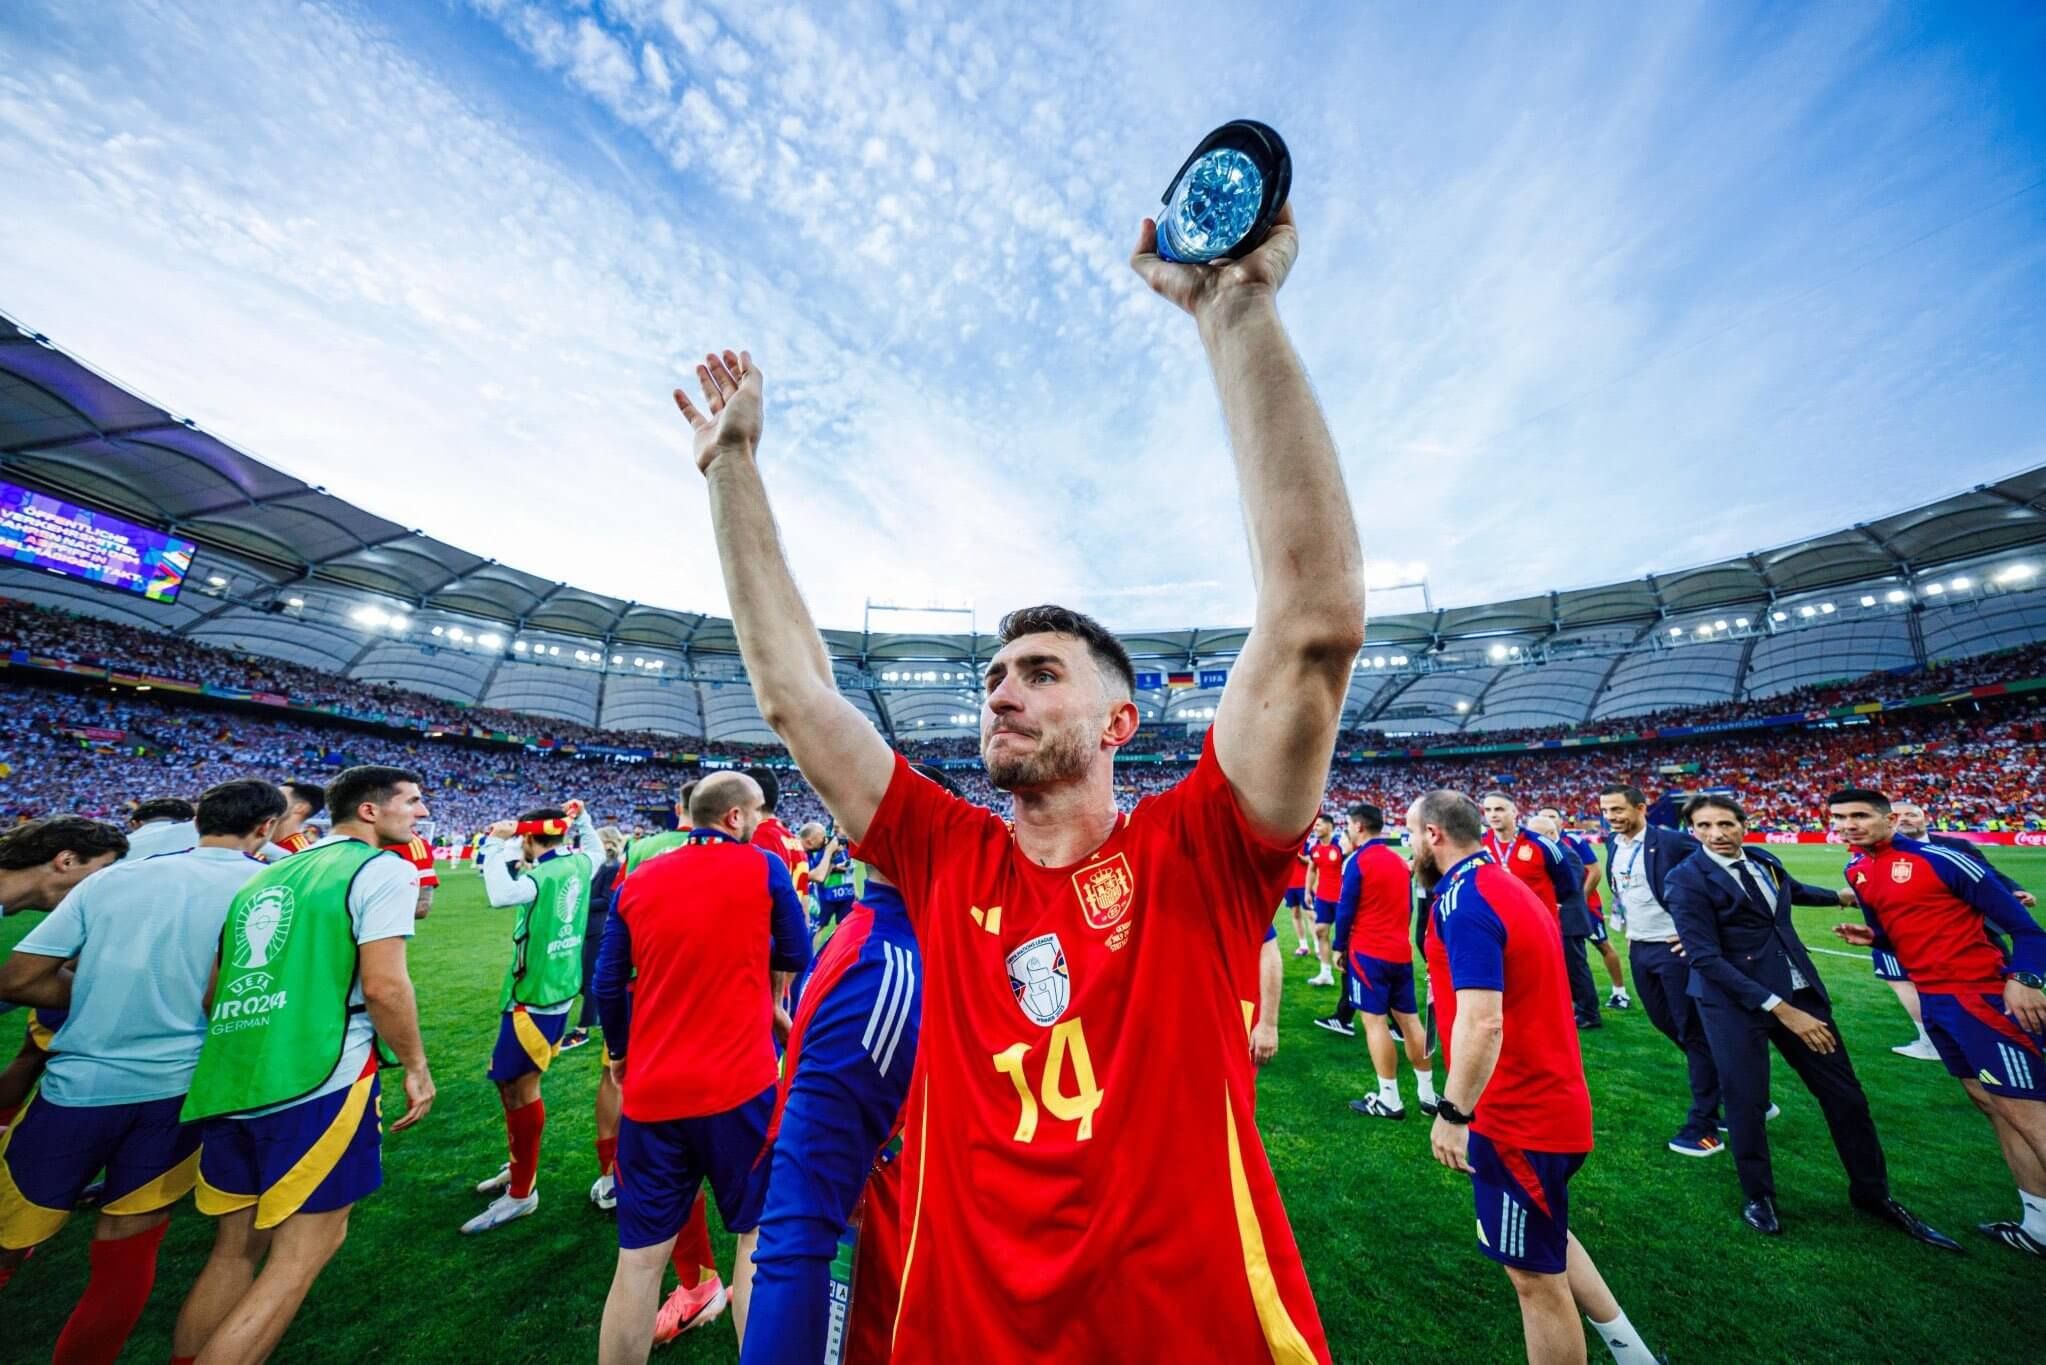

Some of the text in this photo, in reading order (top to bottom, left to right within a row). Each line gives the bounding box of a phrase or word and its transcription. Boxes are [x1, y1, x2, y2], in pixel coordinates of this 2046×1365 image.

[1, 508, 140, 557] VERKEHRSMITTEL
[23, 505, 129, 544] ÖFFENTLICHE
[63, 537, 107, 556] NACH
[1203, 675, 1224, 683] FIFA
[230, 975, 269, 993] UEFA
[992, 1017, 1104, 1143] 14
